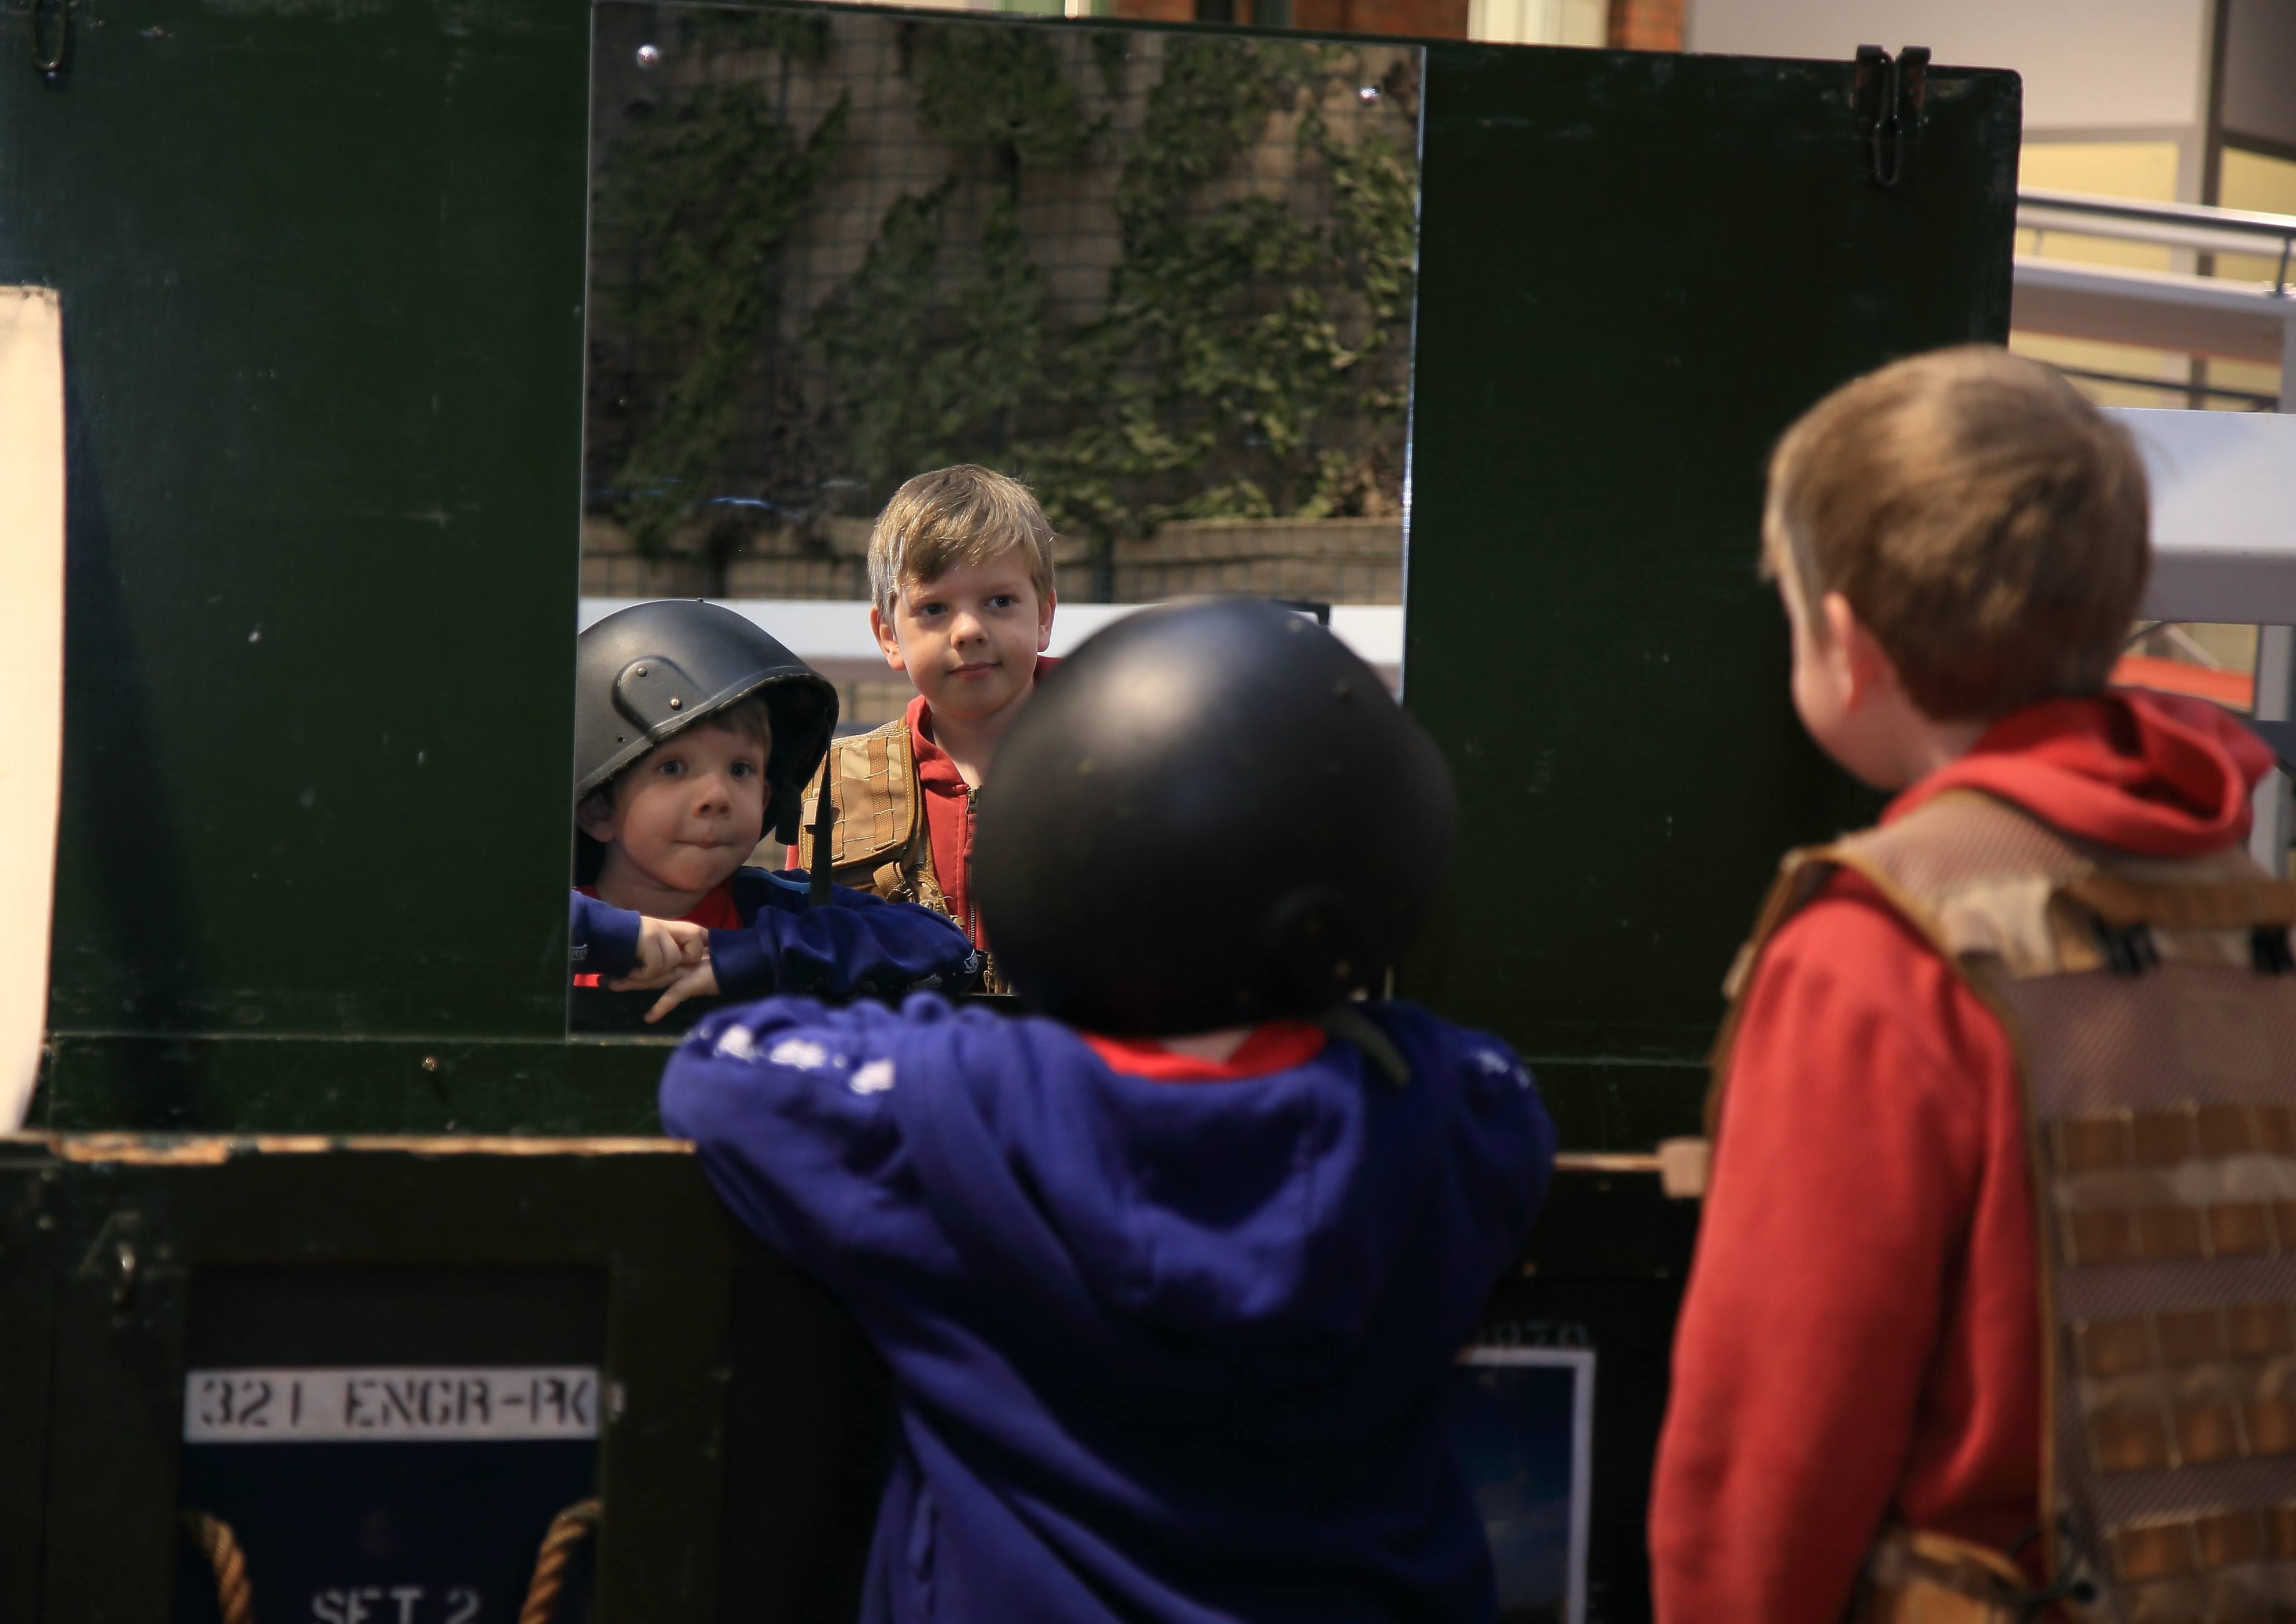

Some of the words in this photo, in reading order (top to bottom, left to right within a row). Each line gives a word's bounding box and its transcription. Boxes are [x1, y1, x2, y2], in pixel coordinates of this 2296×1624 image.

[199, 1379, 302, 1427] 321
[344, 1377, 591, 1426] ENGR-PK
[312, 1587, 425, 1624] SET
[446, 1588, 480, 1624] 2
